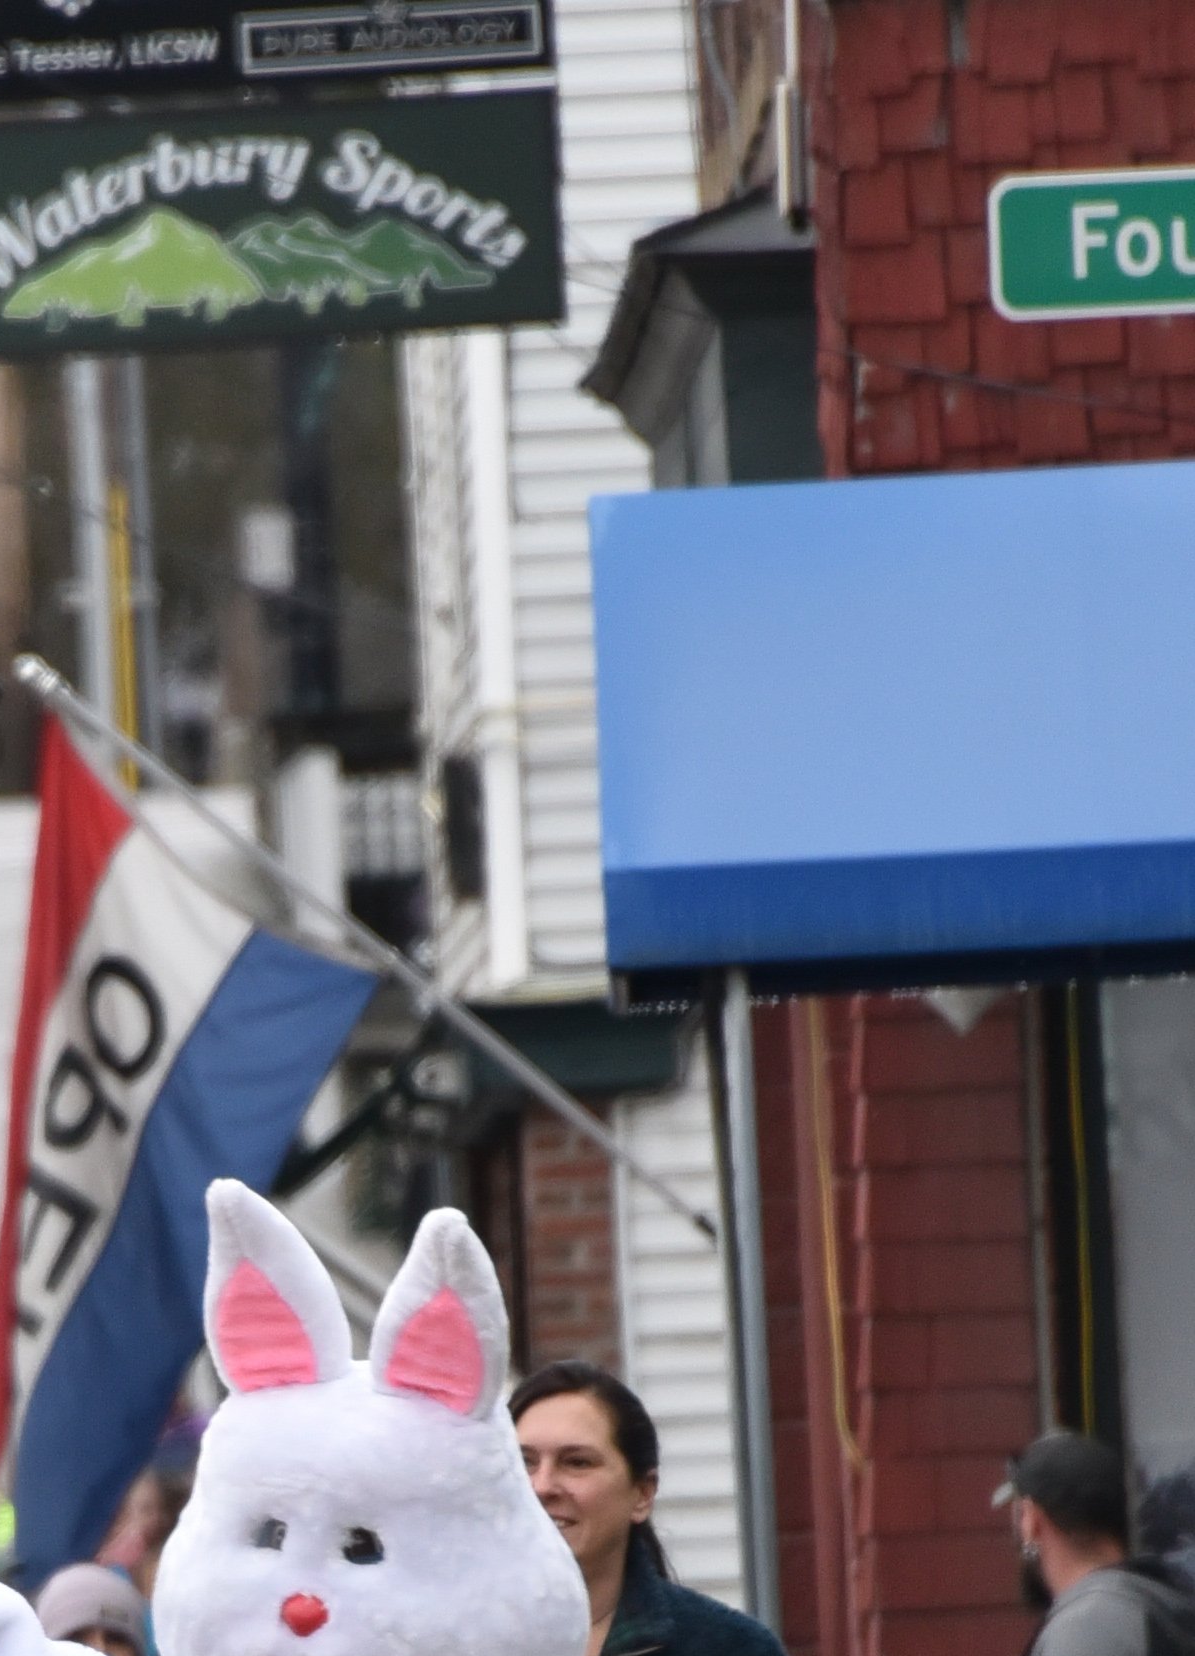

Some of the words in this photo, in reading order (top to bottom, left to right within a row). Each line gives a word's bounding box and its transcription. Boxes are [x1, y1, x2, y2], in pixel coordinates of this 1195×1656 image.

[10, 39, 125, 71] Tessier,
[125, 28, 219, 66] LICSW
[260, 30, 338, 56] PURE
[350, 18, 517, 52] AUDIOLOGY
[323, 130, 528, 268] Sports
